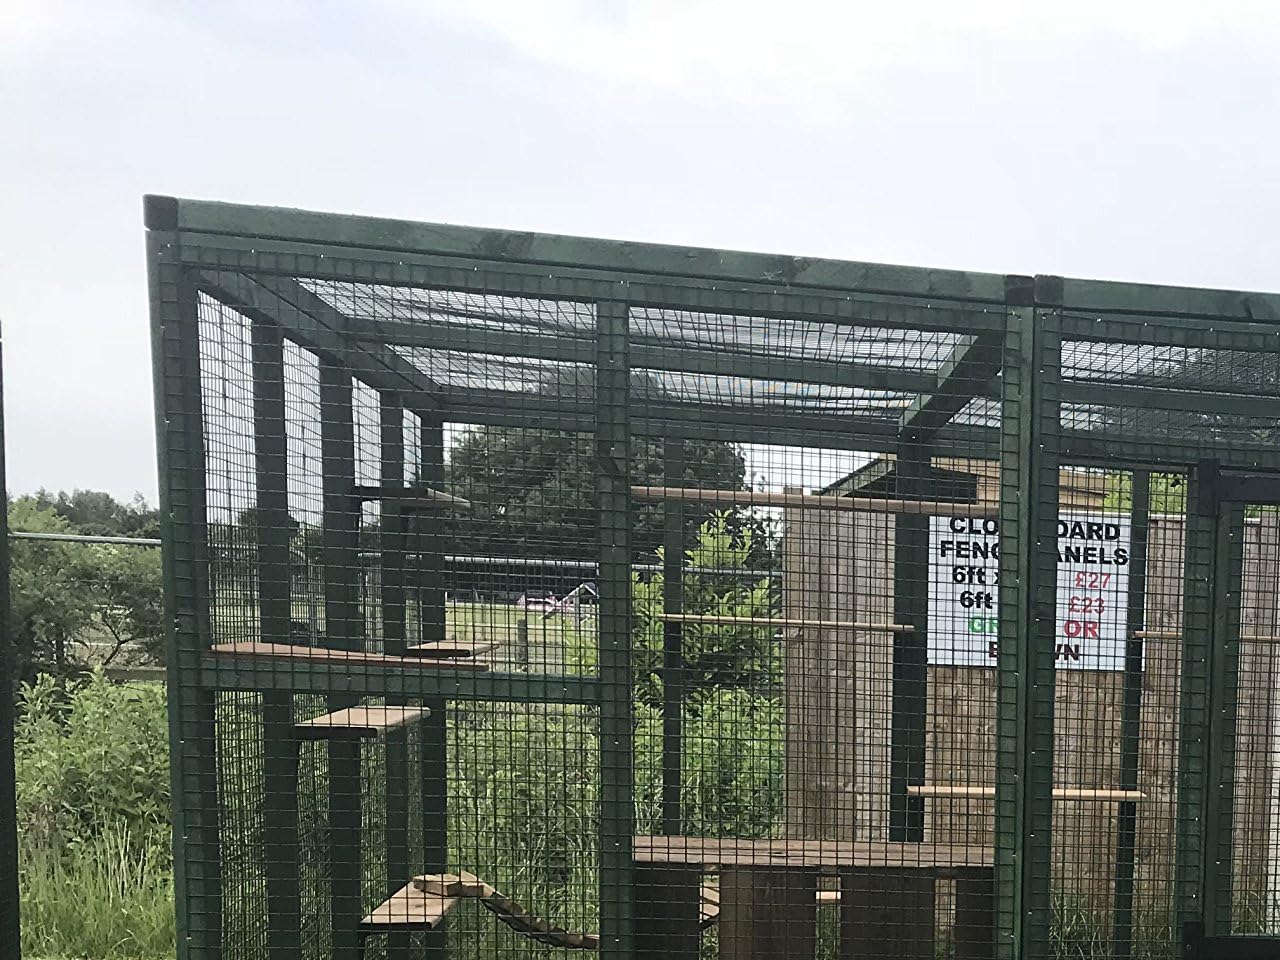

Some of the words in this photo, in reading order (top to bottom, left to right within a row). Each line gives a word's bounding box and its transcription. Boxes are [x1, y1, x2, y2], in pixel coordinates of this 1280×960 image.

[953, 566, 986, 584] 6ft
[1075, 571, 1112, 589] £27
[960, 590, 993, 609] 6ft
[1069, 596, 1105, 614] £23
[1064, 621, 1098, 639] OR
